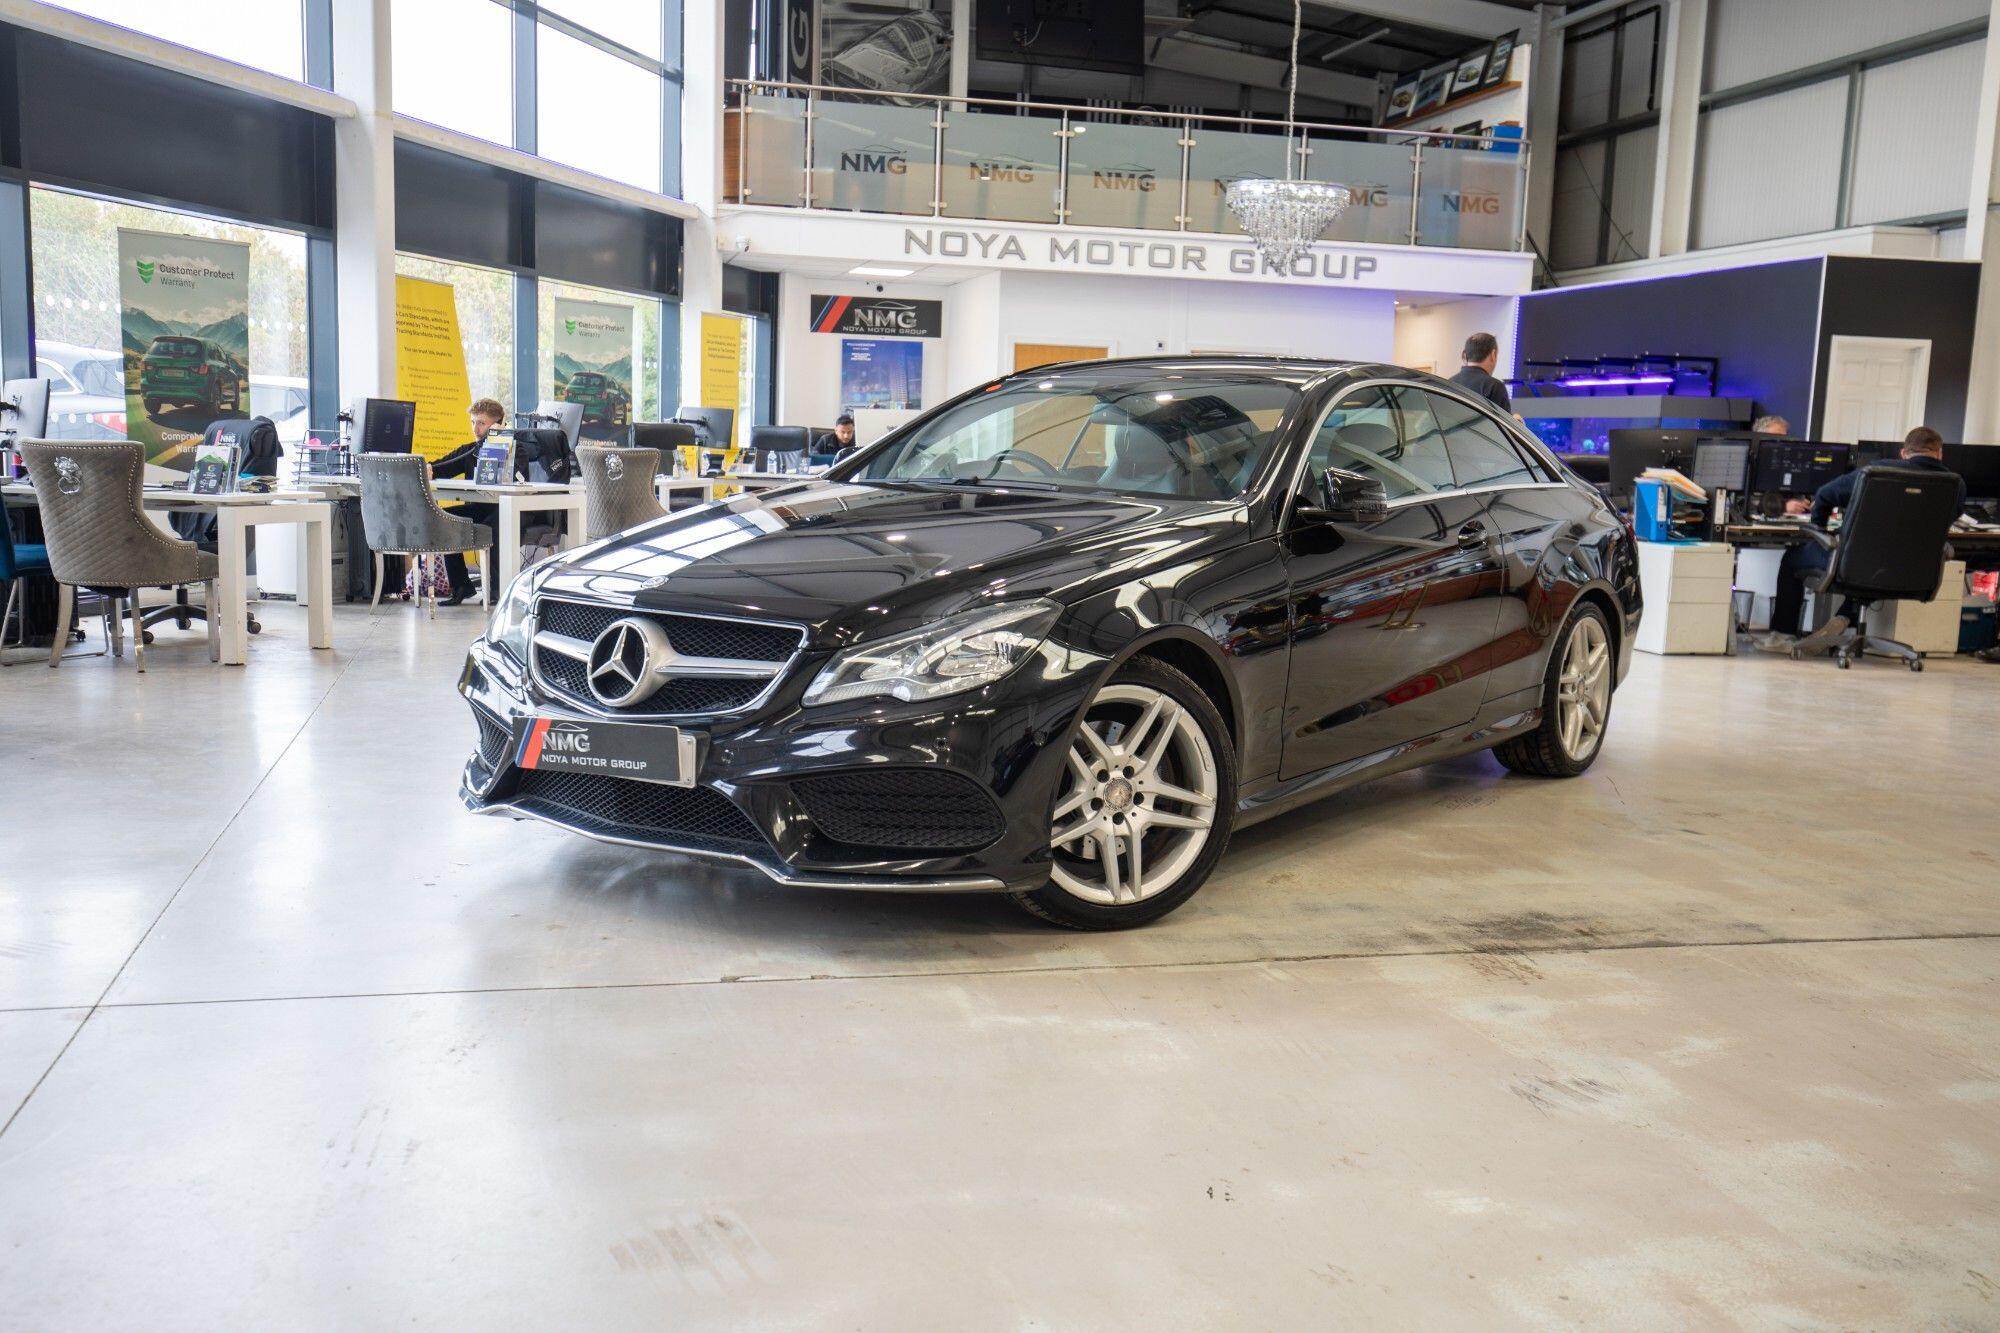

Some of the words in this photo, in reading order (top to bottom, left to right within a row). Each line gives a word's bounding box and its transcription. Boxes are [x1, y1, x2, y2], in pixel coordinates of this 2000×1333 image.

[840, 152, 907, 174] NMG
[969, 161, 1034, 183] NMG
[1093, 171, 1157, 192] NMG
[1350, 188, 1388, 207] MG
[1443, 194, 1500, 215] NMG
[904, 228, 1026, 261] NOYA
[1049, 237, 1207, 271] MOTOR
[159, 263, 201, 277] Customer
[203, 268, 235, 280] Protect
[160, 278, 195, 289] Warranty
[578, 321, 604, 330] Customer
[854, 308, 917, 328] NMG
[161, 431, 205, 442] Comprehe
[541, 731, 591, 753] NMG
[541, 754, 569, 764] NOYA
[571, 756, 608, 767] MOTOR
[610, 759, 647, 770] GROUP
